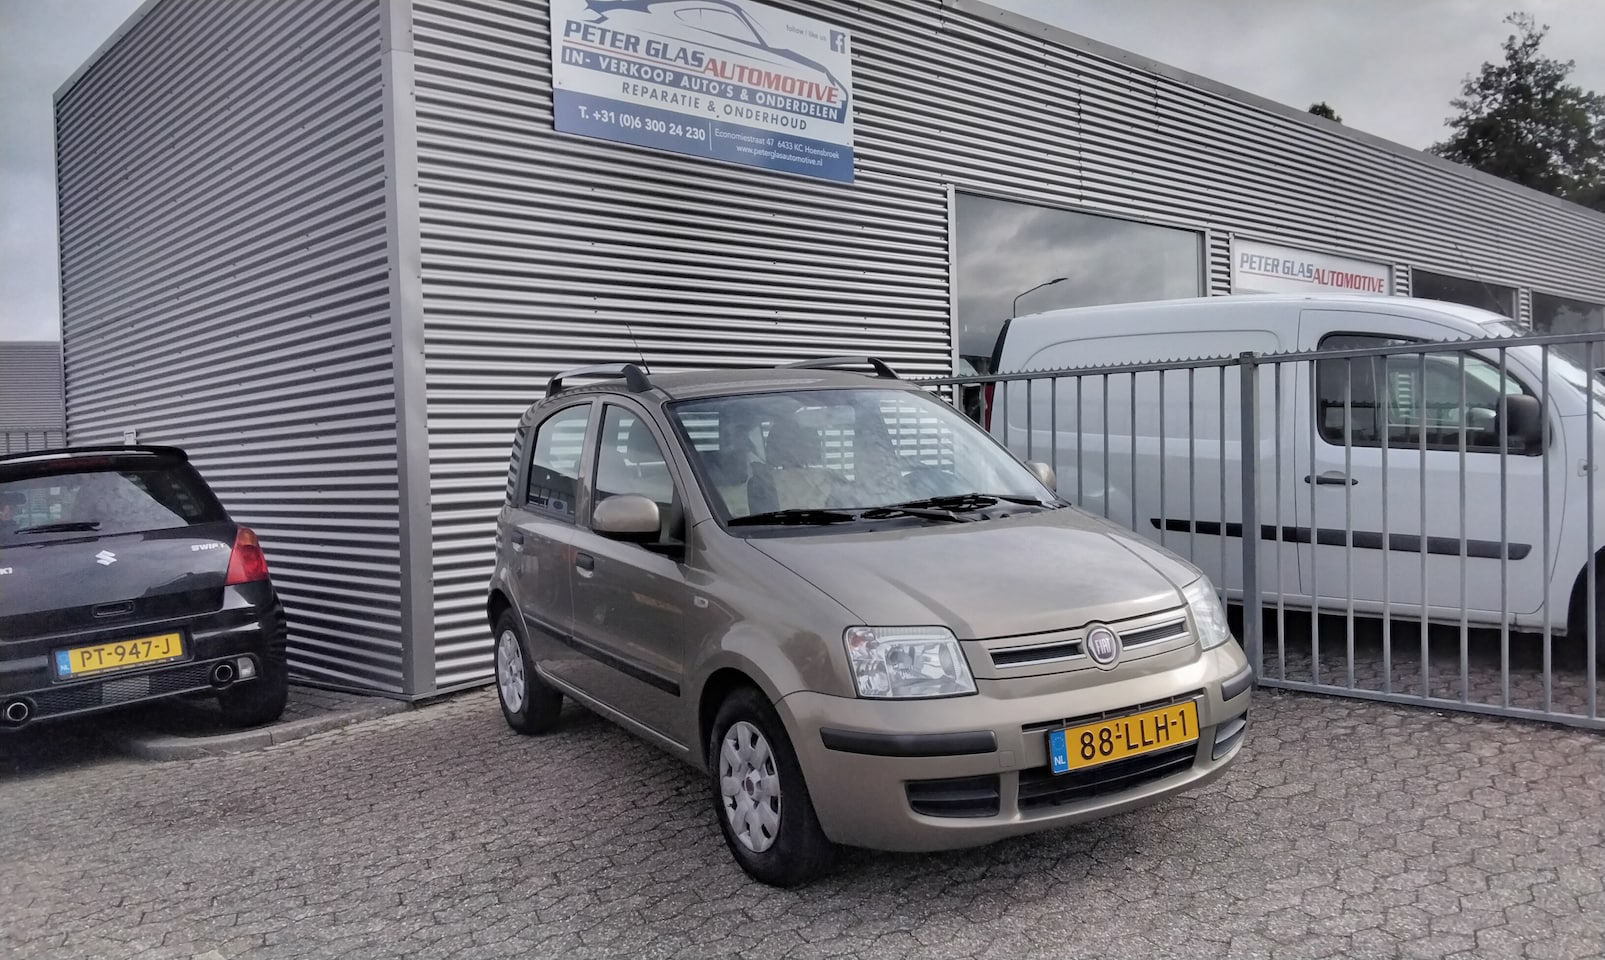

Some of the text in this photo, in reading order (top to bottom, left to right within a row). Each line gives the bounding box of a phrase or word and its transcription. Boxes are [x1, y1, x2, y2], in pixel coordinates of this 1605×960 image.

[563, 19, 641, 53] PETER
[565, 48, 838, 120] IN- VERKOOP AUTO'S & ONDERDELEN
[622, 82, 807, 130] REPARATIE & ONDERHOUD
[578, 105, 706, 141] T. +31 (0)6 300 24 230
[715, 128, 840, 159] Economiestraat 47 6433 KC Hoensbroek
[736, 145, 823, 167] www.peterglasautomotive.nl
[1240, 252, 1280, 274] PETER
[80, 638, 171, 668] PT-947-J
[1094, 638, 1112, 656] FIAT
[1080, 709, 1188, 760] 88-LLH-1
[1054, 756, 1067, 766] NL
